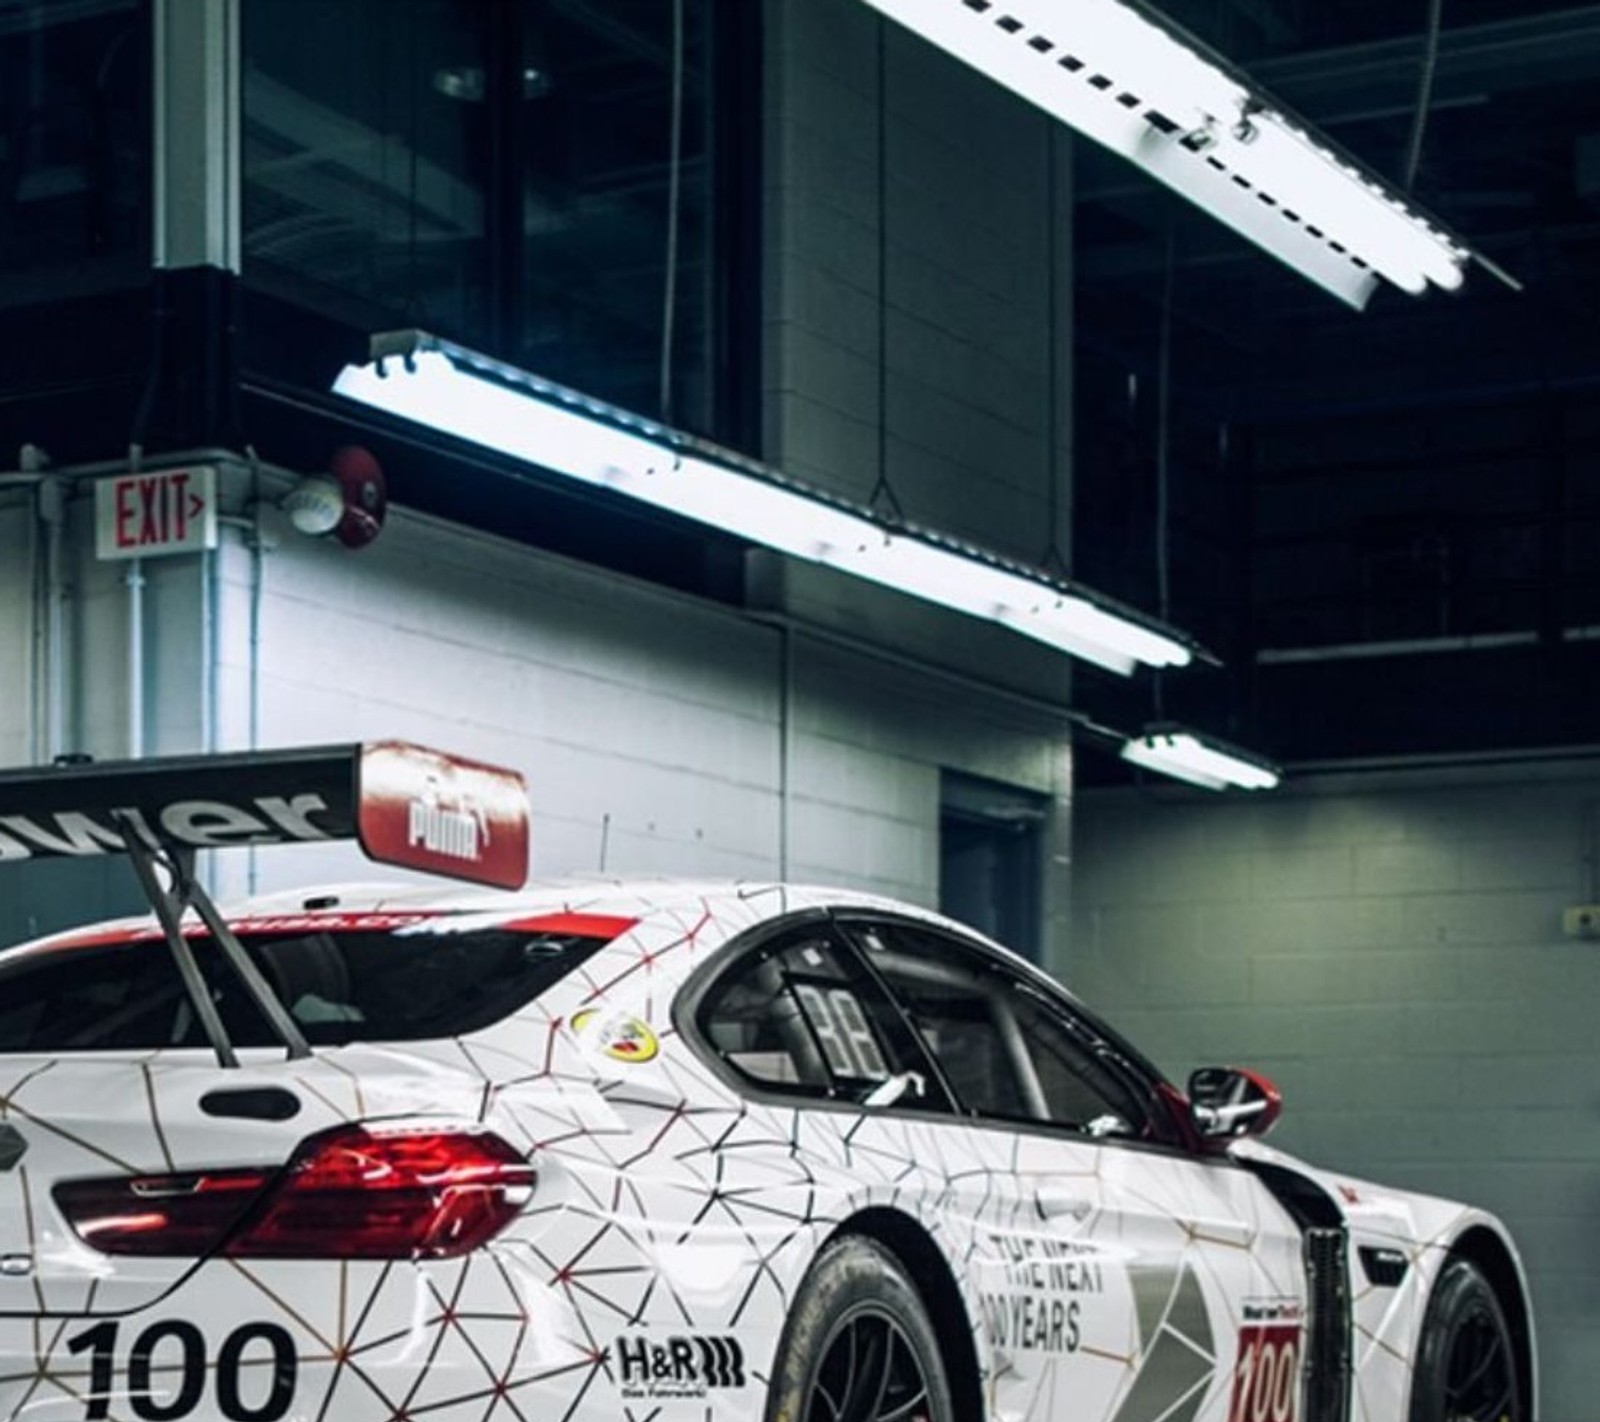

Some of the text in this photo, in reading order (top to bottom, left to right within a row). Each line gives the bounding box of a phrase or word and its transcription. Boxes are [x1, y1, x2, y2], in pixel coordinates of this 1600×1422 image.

[115, 474, 190, 548] EXIT
[409, 801, 478, 861] PUMA
[1010, 1295, 1081, 1353] YEARS
[617, 1336, 697, 1380] H&R
